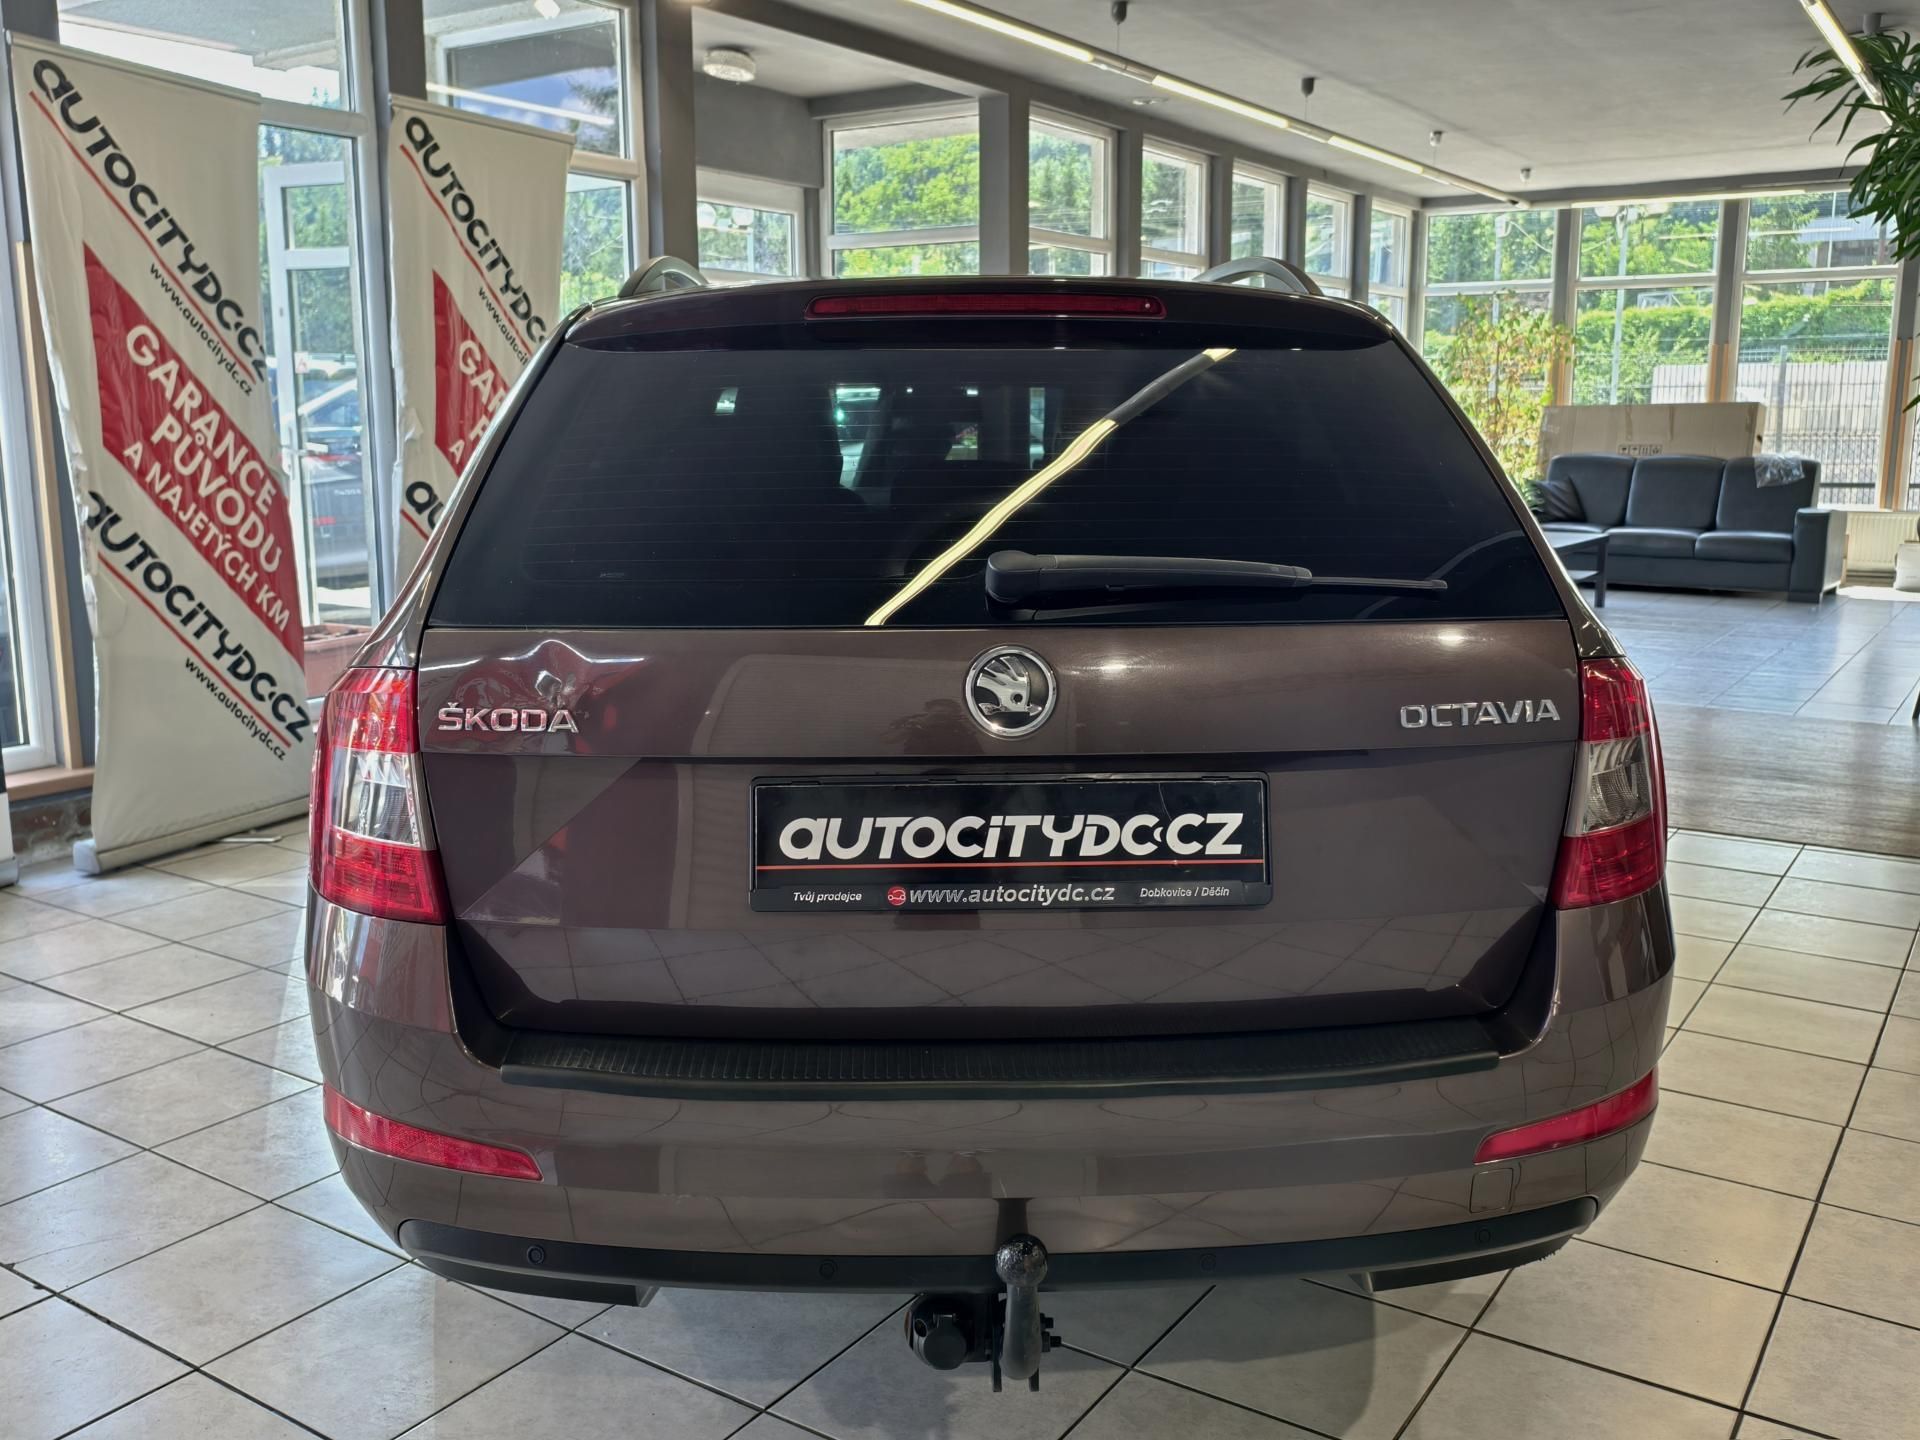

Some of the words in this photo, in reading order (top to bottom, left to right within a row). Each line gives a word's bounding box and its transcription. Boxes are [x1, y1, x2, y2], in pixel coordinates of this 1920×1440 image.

[150, 262, 253, 397] www.autocitydc.cz
[479, 287, 530, 366] www.autocit
[126, 325, 277, 516] GARANCE
[449, 439, 465, 465] A
[151, 413, 282, 573] PŮVODU
[123, 441, 143, 471] A
[145, 461, 258, 592] NAJETÝCH
[256, 584, 290, 632] KM
[185, 657, 286, 760] www.autocitydc.cz
[438, 702, 579, 733] ŠKODA
[1400, 699, 1561, 729] OCTAVIA
[793, 891, 816, 902] Tvůj
[816, 892, 862, 902] prodejce
[910, 884, 1115, 906] www.autocitydc.cz
[1140, 887, 1192, 898] Dobkovice
[1201, 886, 1230, 897] Děčín
